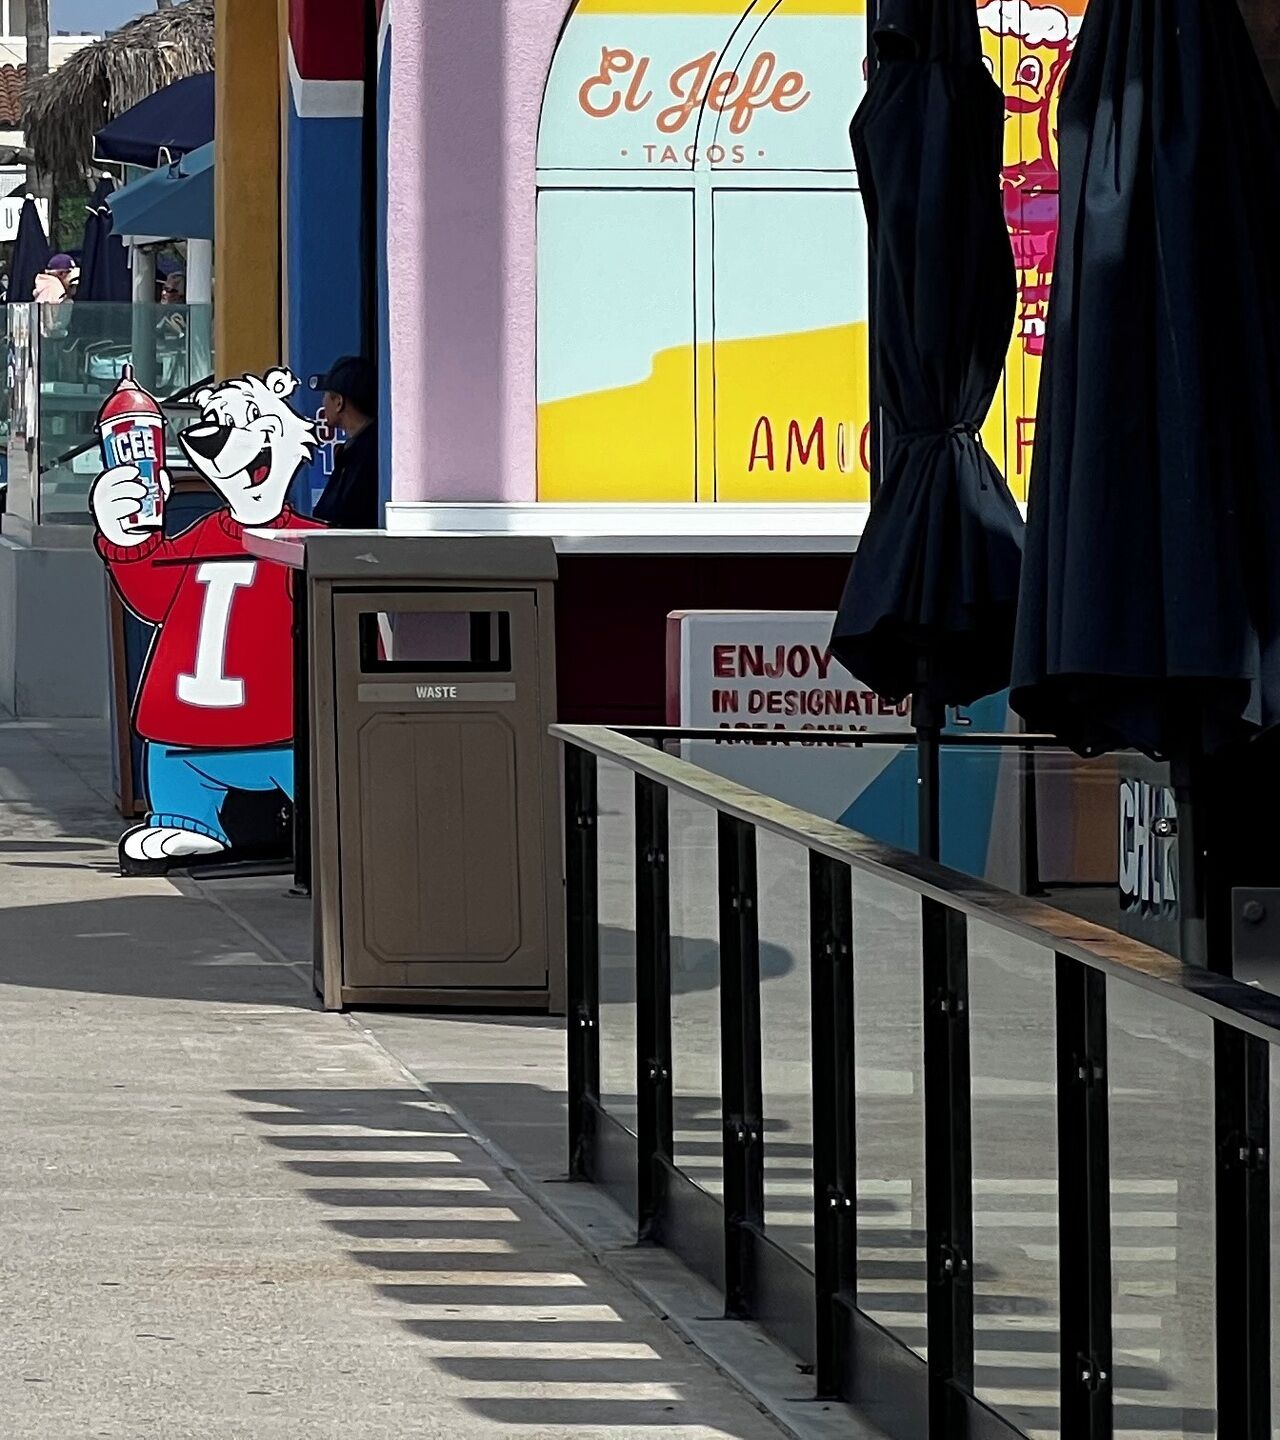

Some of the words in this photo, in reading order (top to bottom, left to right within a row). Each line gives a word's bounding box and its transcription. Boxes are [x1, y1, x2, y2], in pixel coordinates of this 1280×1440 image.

[579, 46, 653, 118] El
[657, 51, 811, 133] Jefe
[643, 145, 745, 163] TACOS
[111, 427, 157, 467] ICEE
[177, 561, 257, 707] I
[713, 645, 832, 679] ENJOY
[415, 686, 457, 699] WASTE
[712, 689, 739, 713] IN
